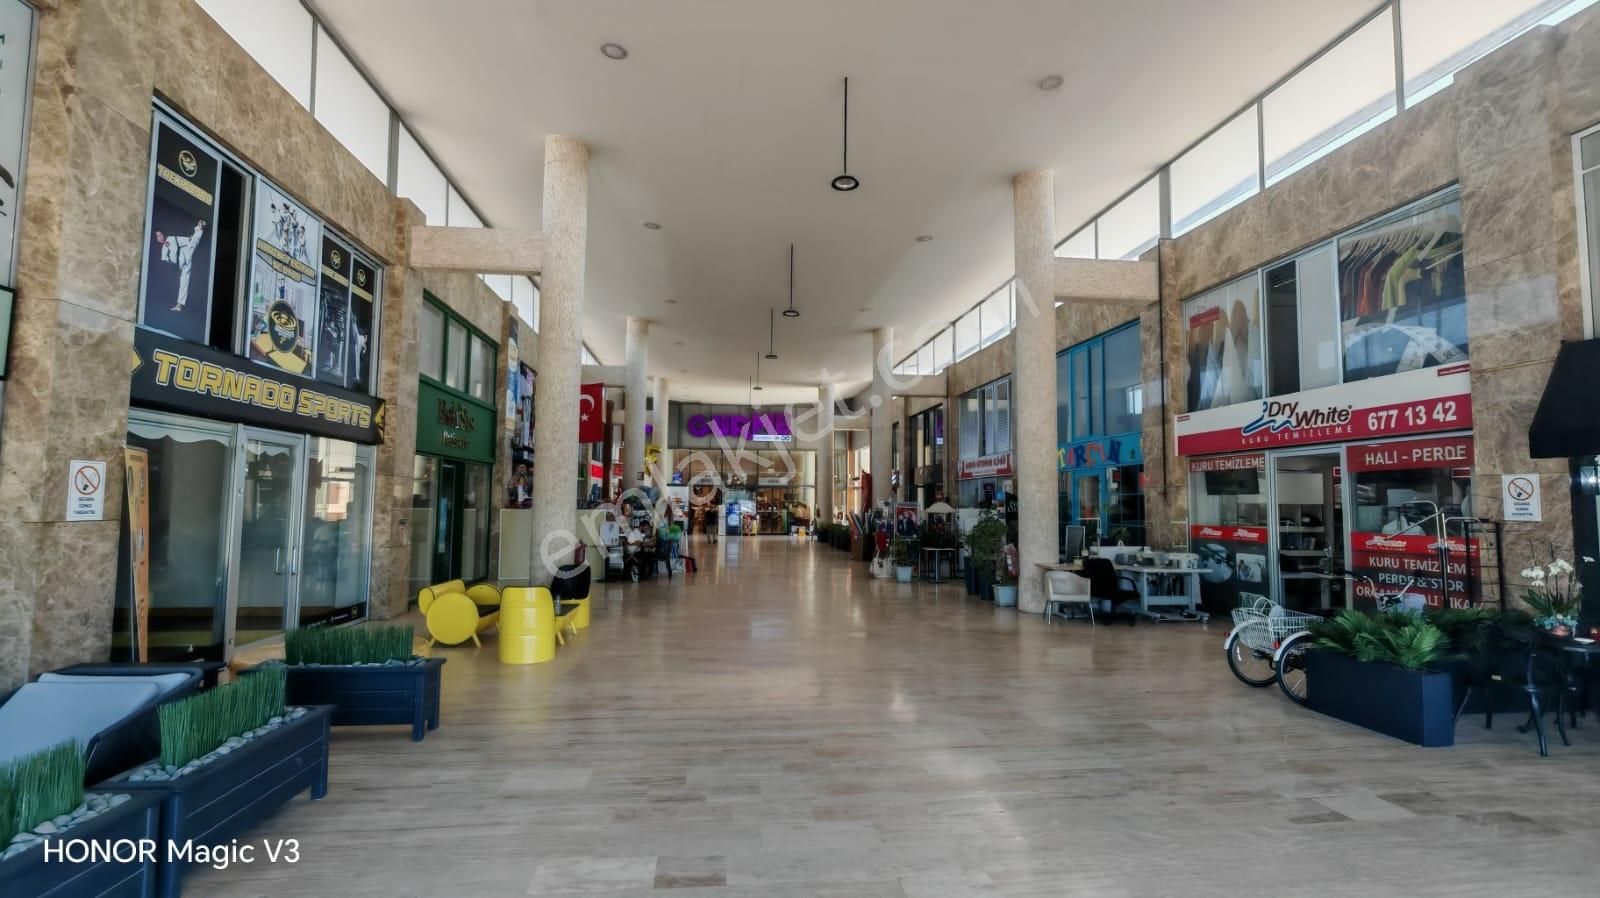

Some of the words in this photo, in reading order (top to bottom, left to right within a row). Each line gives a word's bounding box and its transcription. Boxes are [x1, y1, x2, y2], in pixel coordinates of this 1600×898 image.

[153, 349, 296, 413] TORNADO
[297, 388, 373, 429] SPORTS
[1268, 401, 1299, 418] Dry
[1295, 406, 1350, 427] White
[1367, 409, 1399, 431] 677
[1405, 405, 1427, 426] 13
[1432, 401, 1457, 423] 42
[1241, 435, 1269, 444] KURU
[1191, 460, 1213, 472] KURU
[1215, 456, 1264, 471] TEMİZLEME
[1365, 450, 1398, 466] HALI
[1412, 445, 1467, 462] PERDE
[1369, 556, 1400, 569] KURU
[1403, 558, 1475, 576] TEMİZEM
